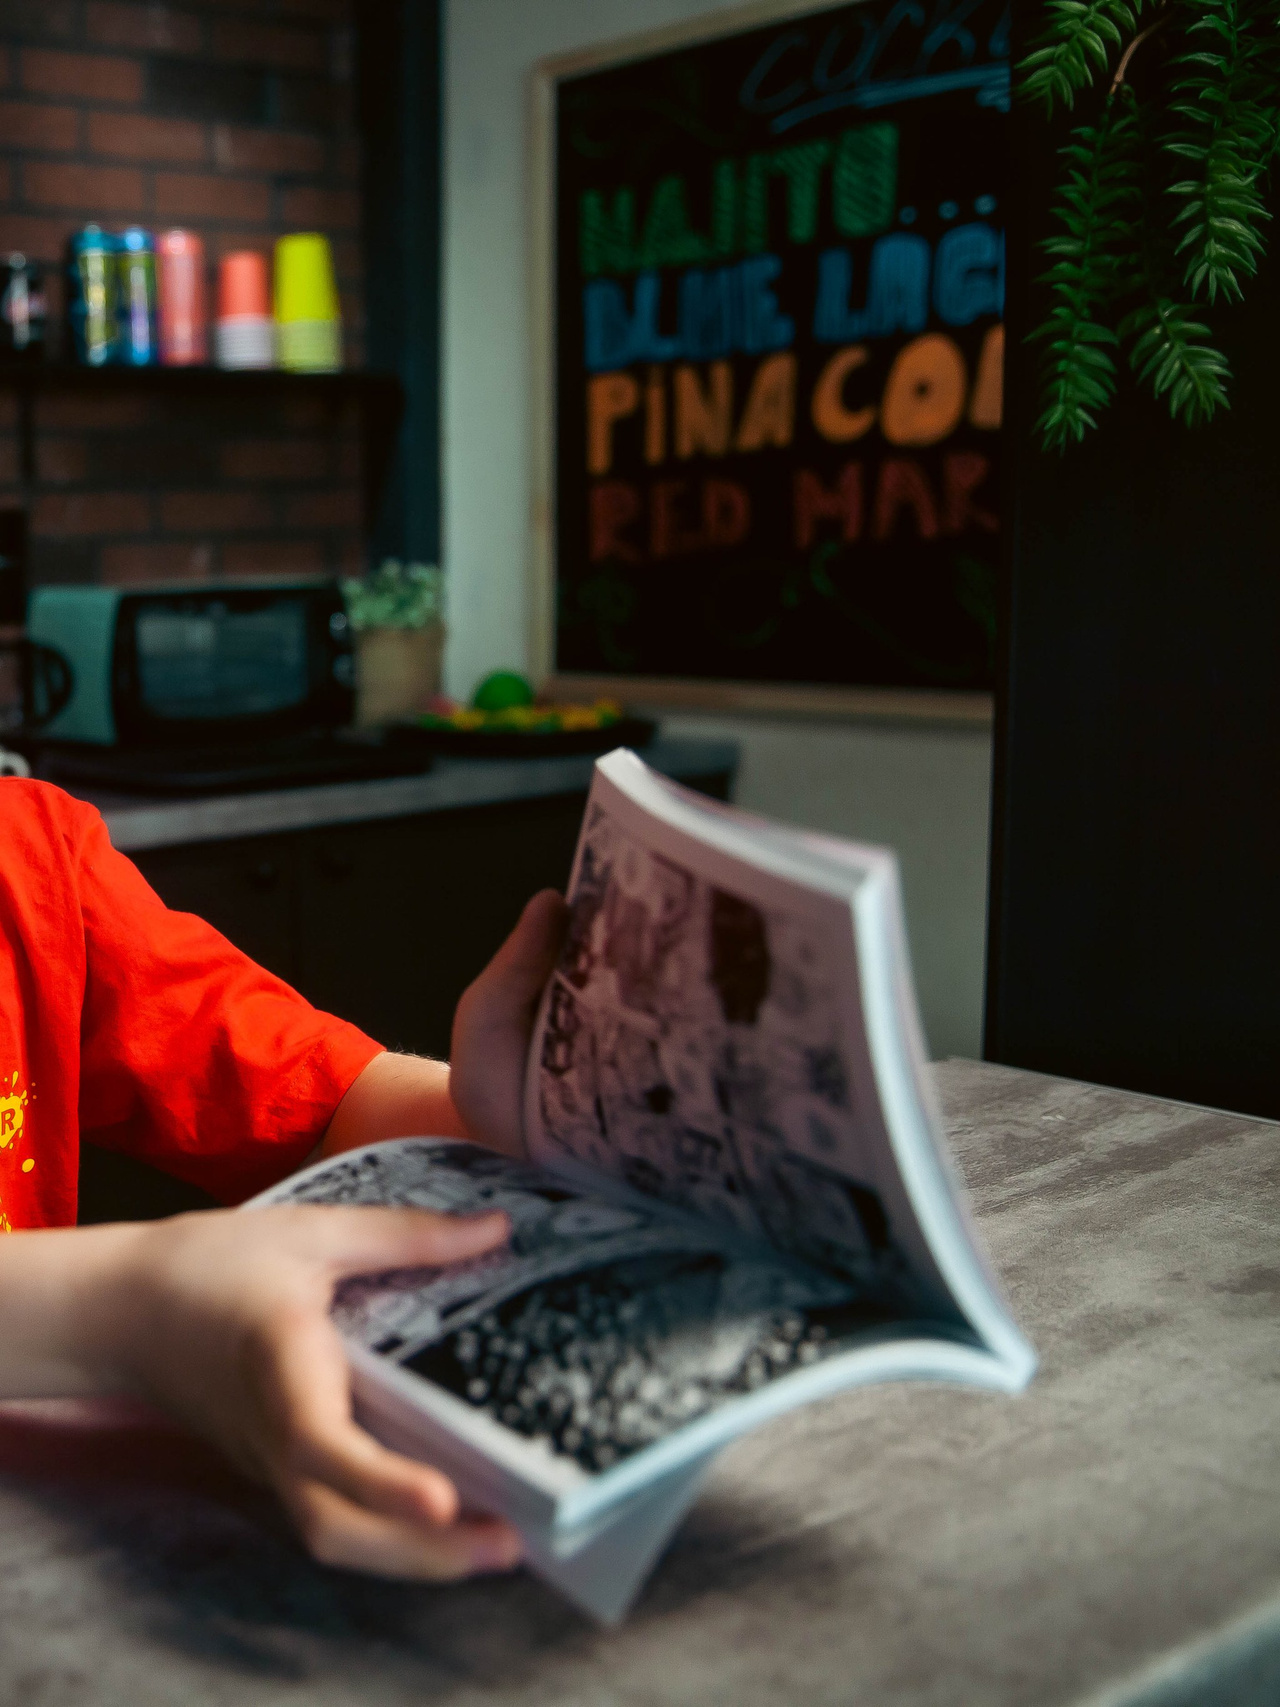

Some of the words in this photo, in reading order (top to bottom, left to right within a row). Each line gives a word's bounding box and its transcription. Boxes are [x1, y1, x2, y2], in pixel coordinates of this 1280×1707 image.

[813, 221, 1005, 343] LAG
[588, 477, 751, 563] RED
[0, 1108, 16, 1136] R
